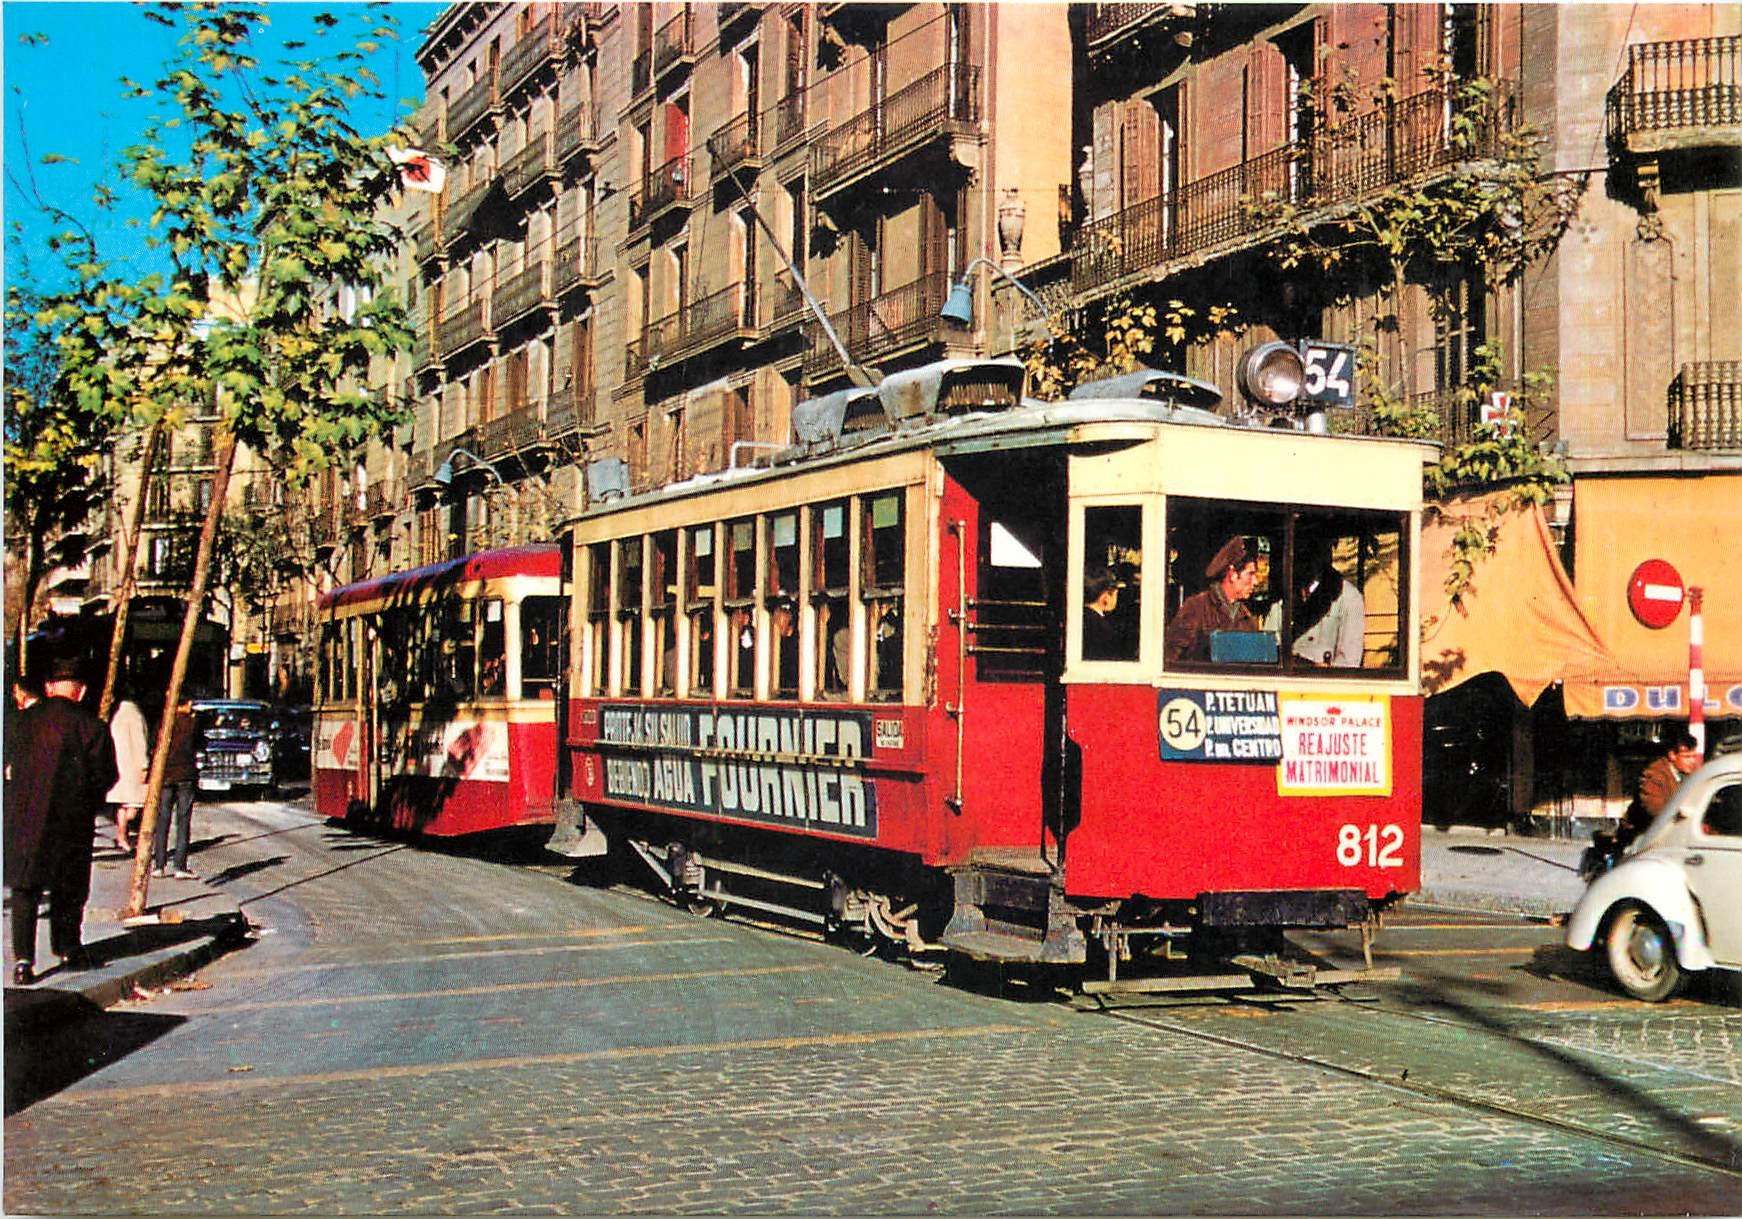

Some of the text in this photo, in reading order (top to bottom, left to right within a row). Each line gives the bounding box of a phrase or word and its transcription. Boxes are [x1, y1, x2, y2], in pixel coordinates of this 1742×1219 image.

[1305, 349, 1350, 397] 54
[699, 713, 862, 758] FOURNIER
[1167, 708, 1201, 738] 54
[1286, 717, 1382, 728] WINDSOR PALACE
[1298, 733, 1368, 756] REAJUSTE
[1286, 760, 1380, 784] MATRIMONIAL
[653, 756, 696, 804] AGUA
[701, 760, 867, 828] FOURNIER
[1336, 823, 1404, 869] 812
